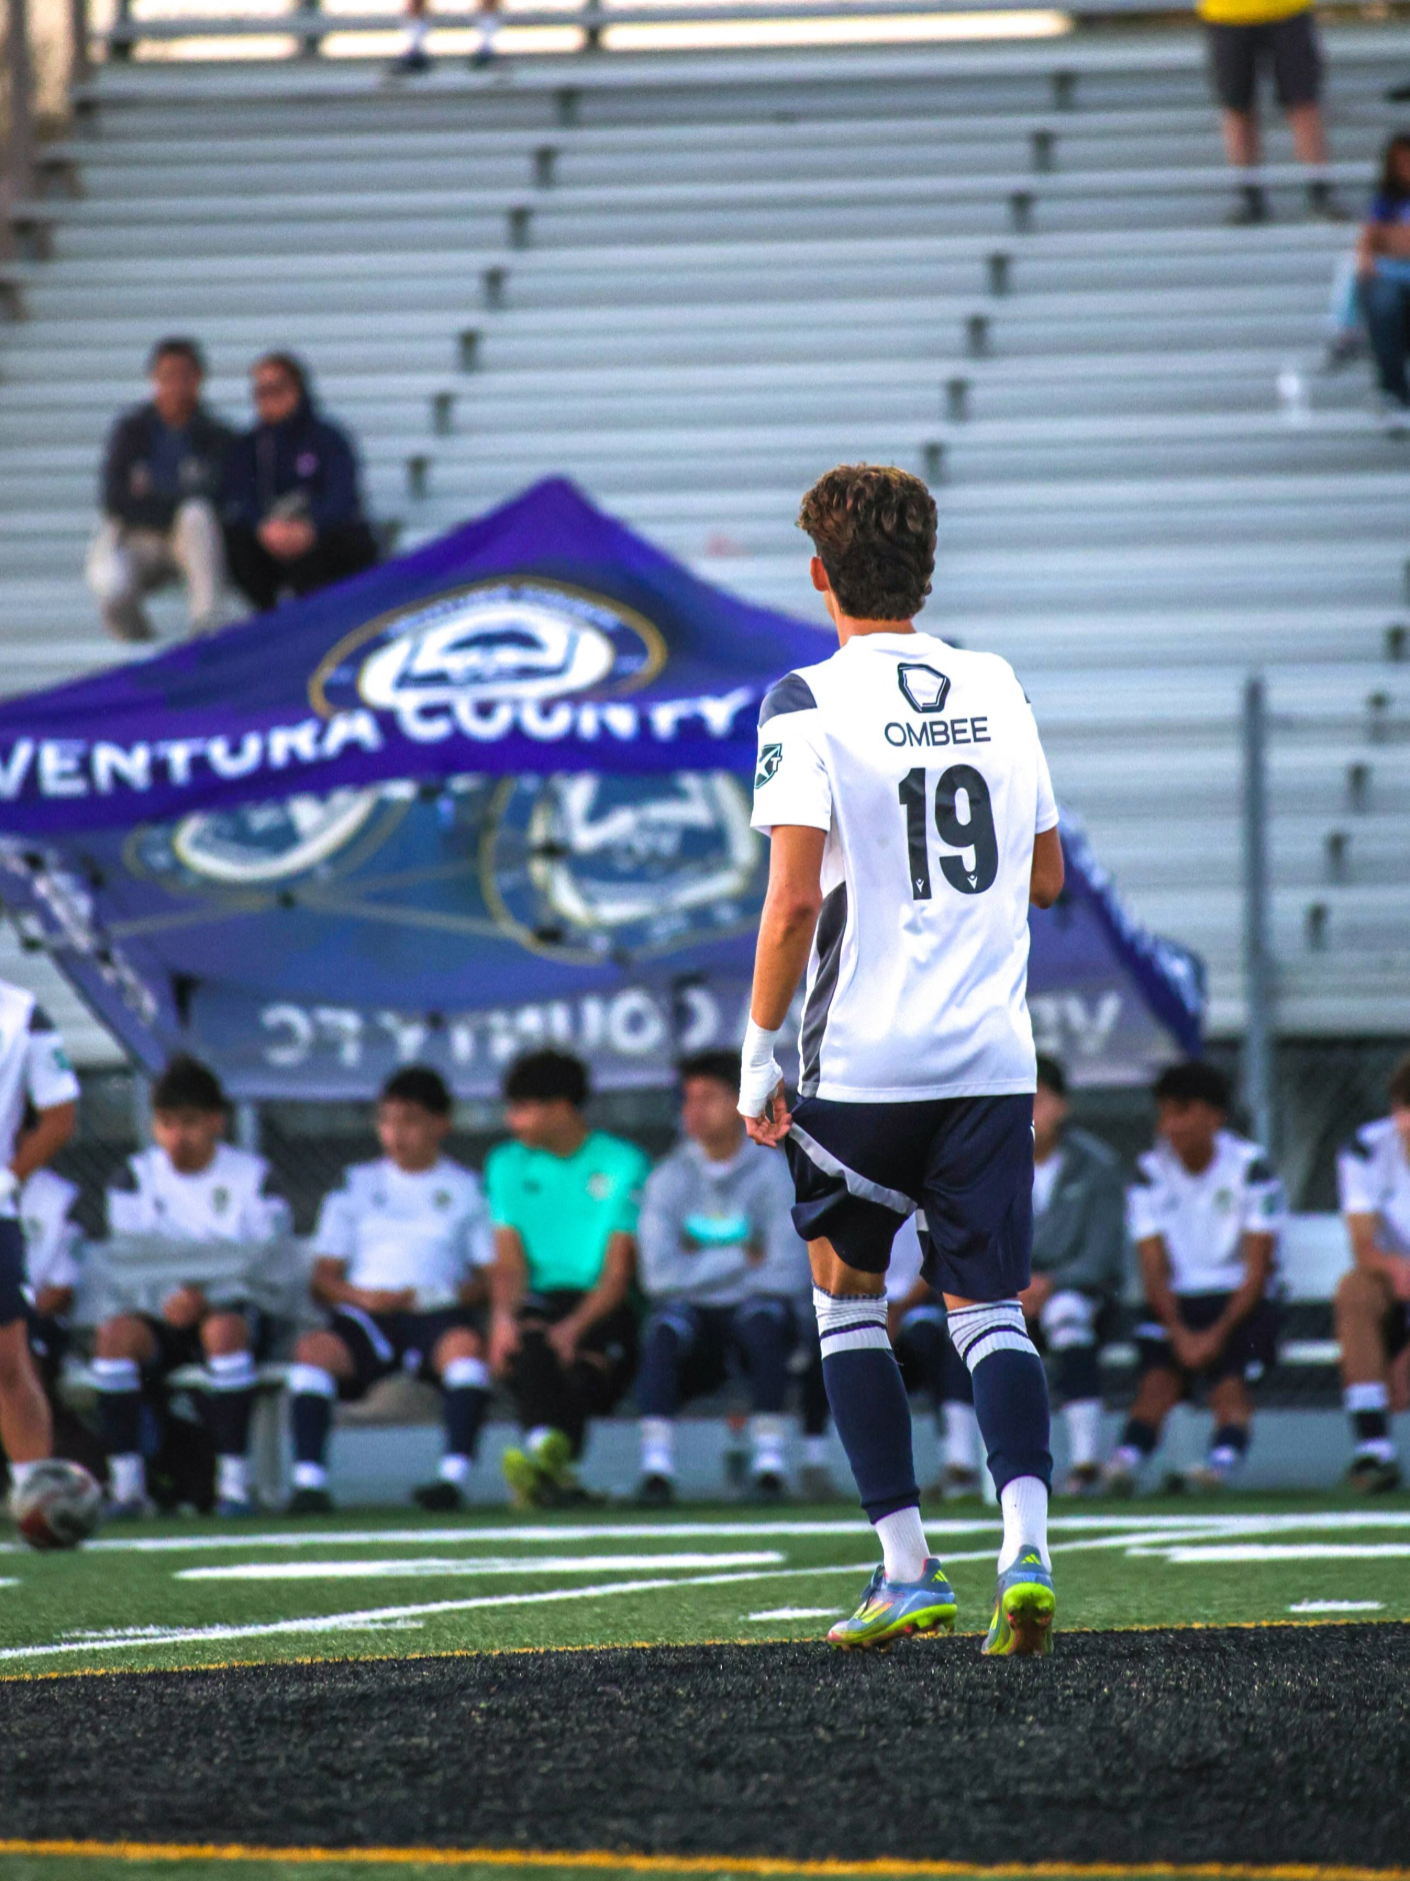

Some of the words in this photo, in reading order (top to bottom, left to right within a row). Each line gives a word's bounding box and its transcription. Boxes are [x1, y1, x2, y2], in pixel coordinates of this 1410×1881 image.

[0, 708, 382, 798] VENTURA
[398, 686, 752, 742] COUNTY
[884, 716, 991, 747] OMBEE
[898, 763, 999, 901] 19
